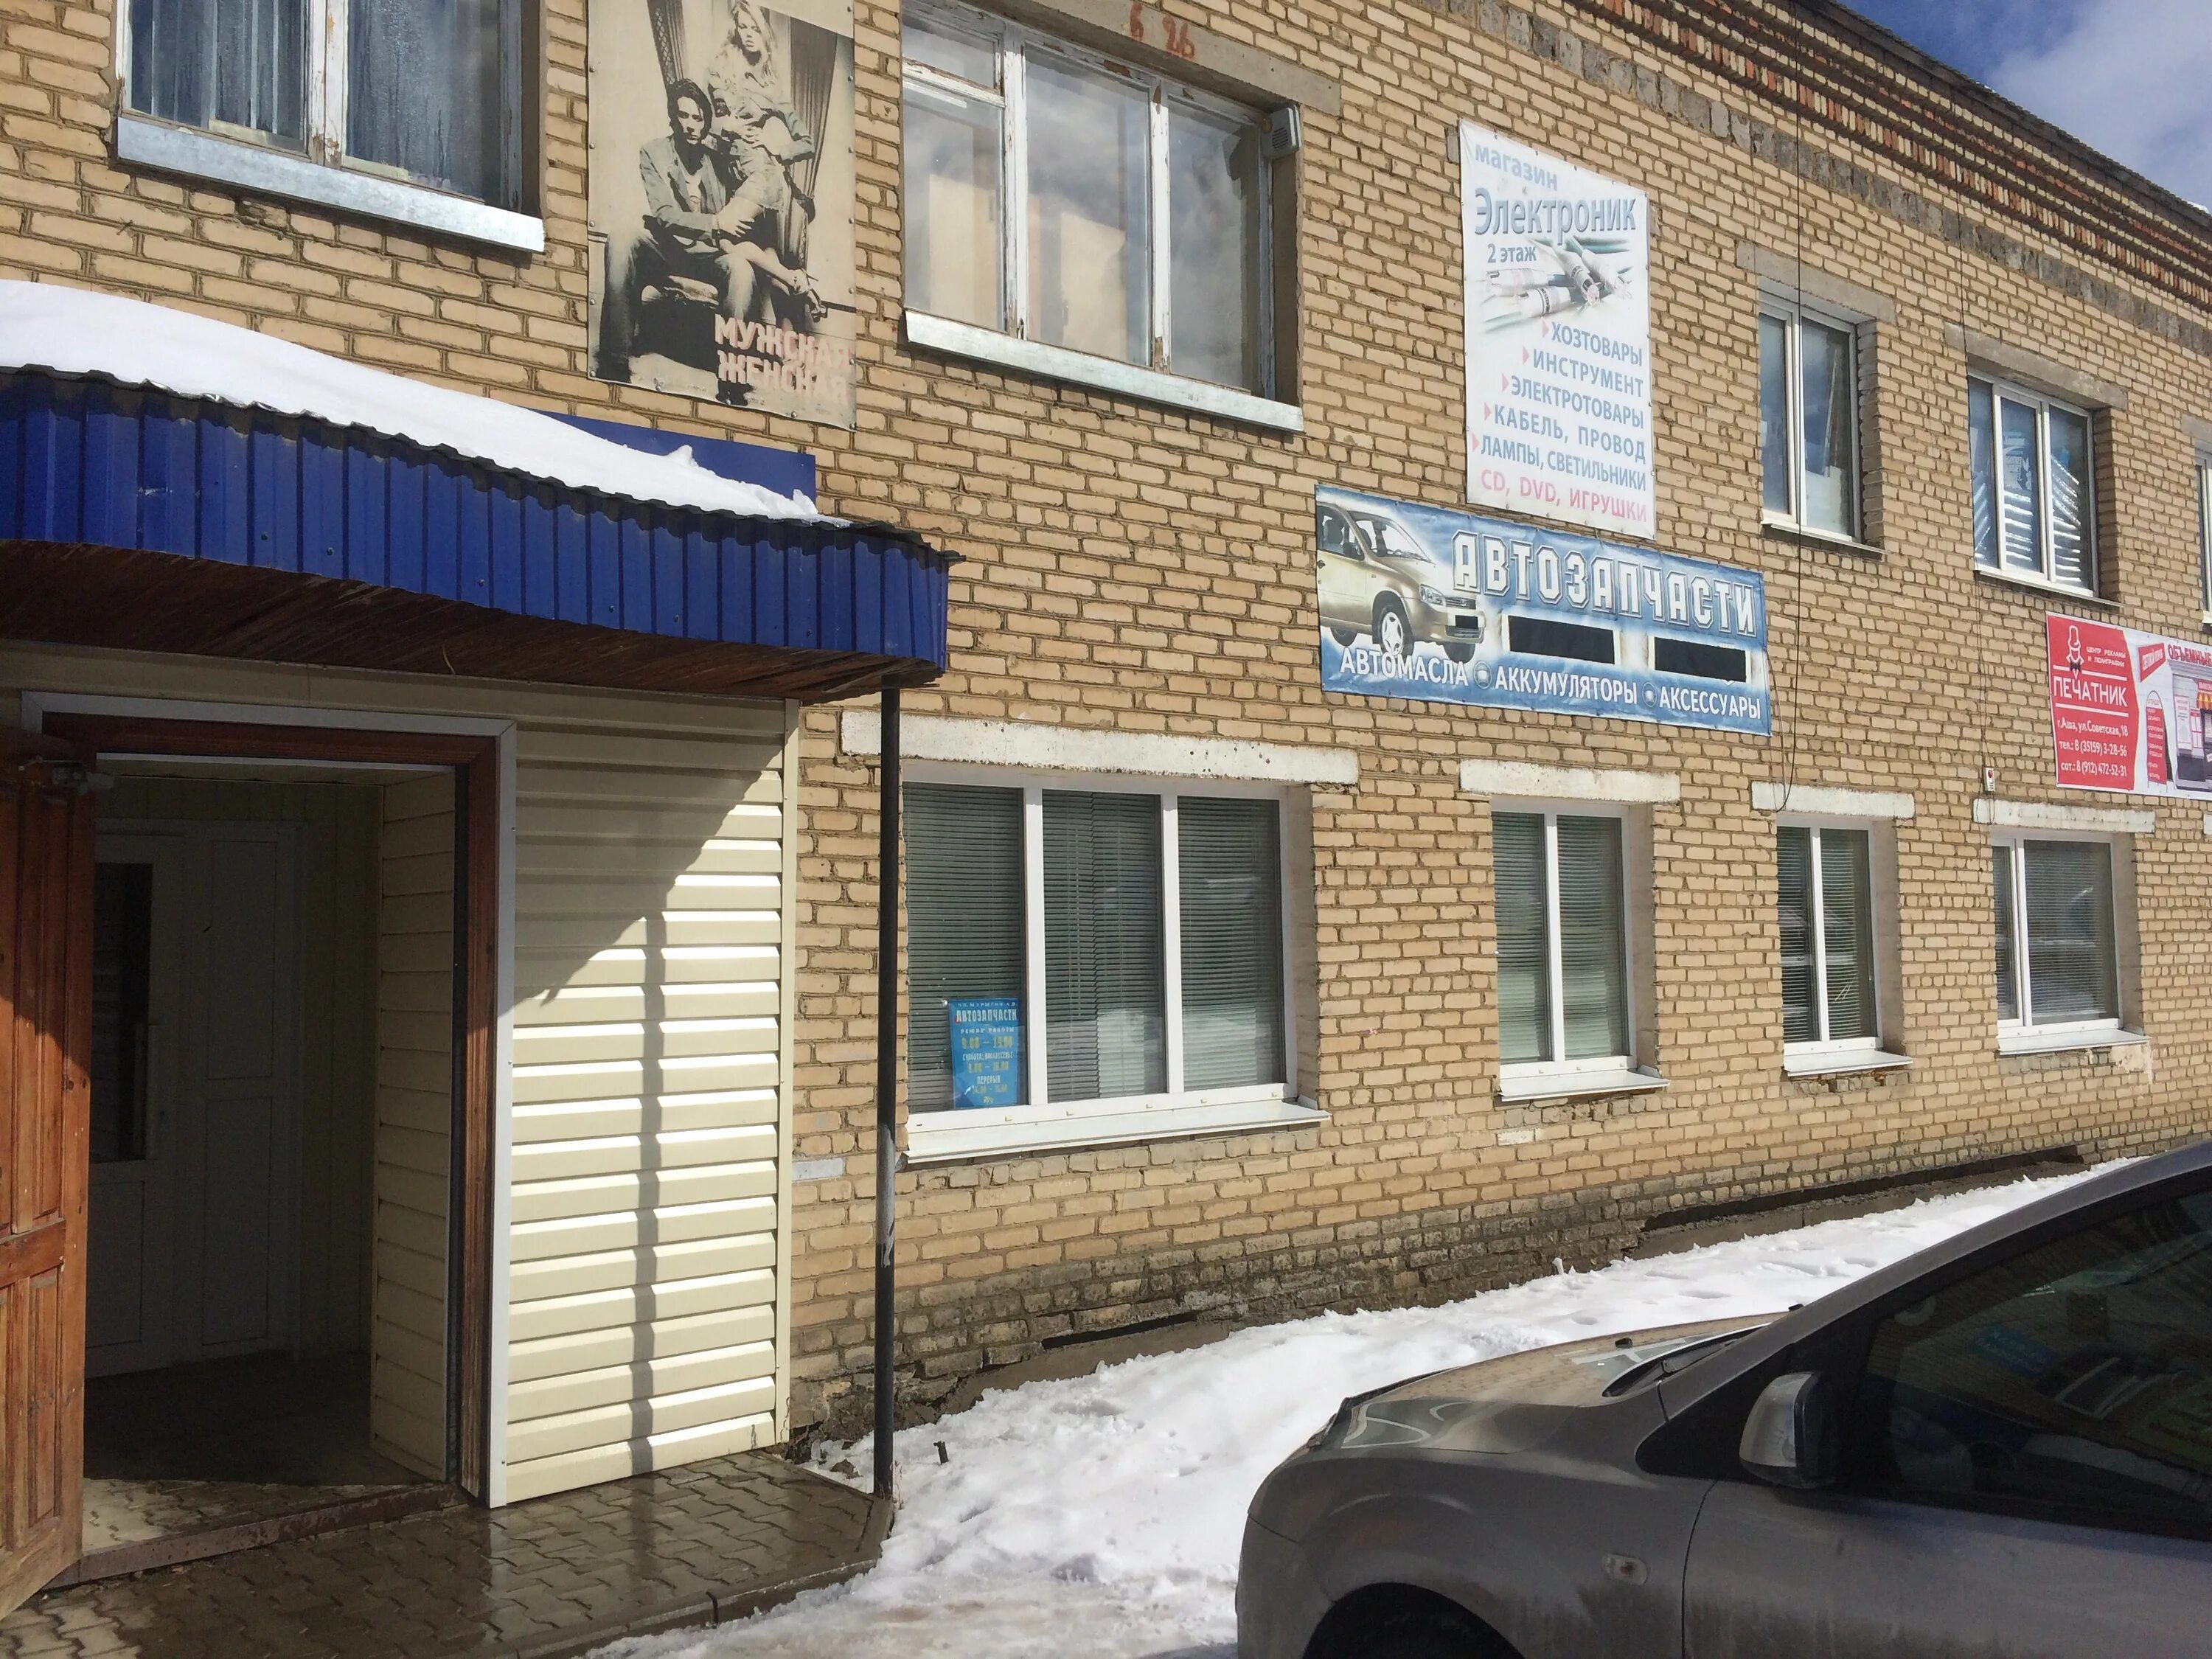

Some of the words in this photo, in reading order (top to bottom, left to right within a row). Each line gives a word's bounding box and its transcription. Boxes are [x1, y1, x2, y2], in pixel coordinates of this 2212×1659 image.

[1475, 144, 1558, 191] магазин
[1475, 187, 1636, 246] Электроник
[1487, 243, 1497, 263] 2
[1500, 246, 1537, 262] этаж
[1551, 321, 1643, 366] ХОЗТОВАРЫ
[1533, 348, 1644, 398] ИНСТРУМЕНТ
[1511, 375, 1644, 429] ЭЛЕКТРОТОВАРЫ
[1494, 403, 1568, 444] КАБЕЛЬ,
[1578, 425, 1646, 465] ПРОВОД
[1481, 434, 1544, 470] ЛАМПЫ,
[1547, 451, 1646, 491] СВЕТИЛЬНИКИ
[1481, 469, 1510, 495] CD,
[1520, 476, 1561, 507] DVD,
[1569, 487, 1646, 522] ИГРУШКИ
[1452, 529, 1757, 637] АВТОЗАПЧАСТИ
[1339, 647, 1469, 687] АВТОМАСЛА
[1494, 665, 1638, 706] АККУМУЛЯТОРЫ
[1659, 687, 1761, 720] АКСЕССУАРЫ
[2053, 675, 2128, 707] ПЕЧАТНИК
[2074, 739, 2079, 751] 8
[2080, 740, 2102, 757] (35159)
[2103, 742, 2127, 757] 3-28-56
[2076, 760, 2081, 772] 8
[2081, 760, 2098, 775] (912)
[2098, 762, 2127, 777] 472-52-31
[956, 1008, 1017, 1023] АВТОЗАПЧАСТИ
